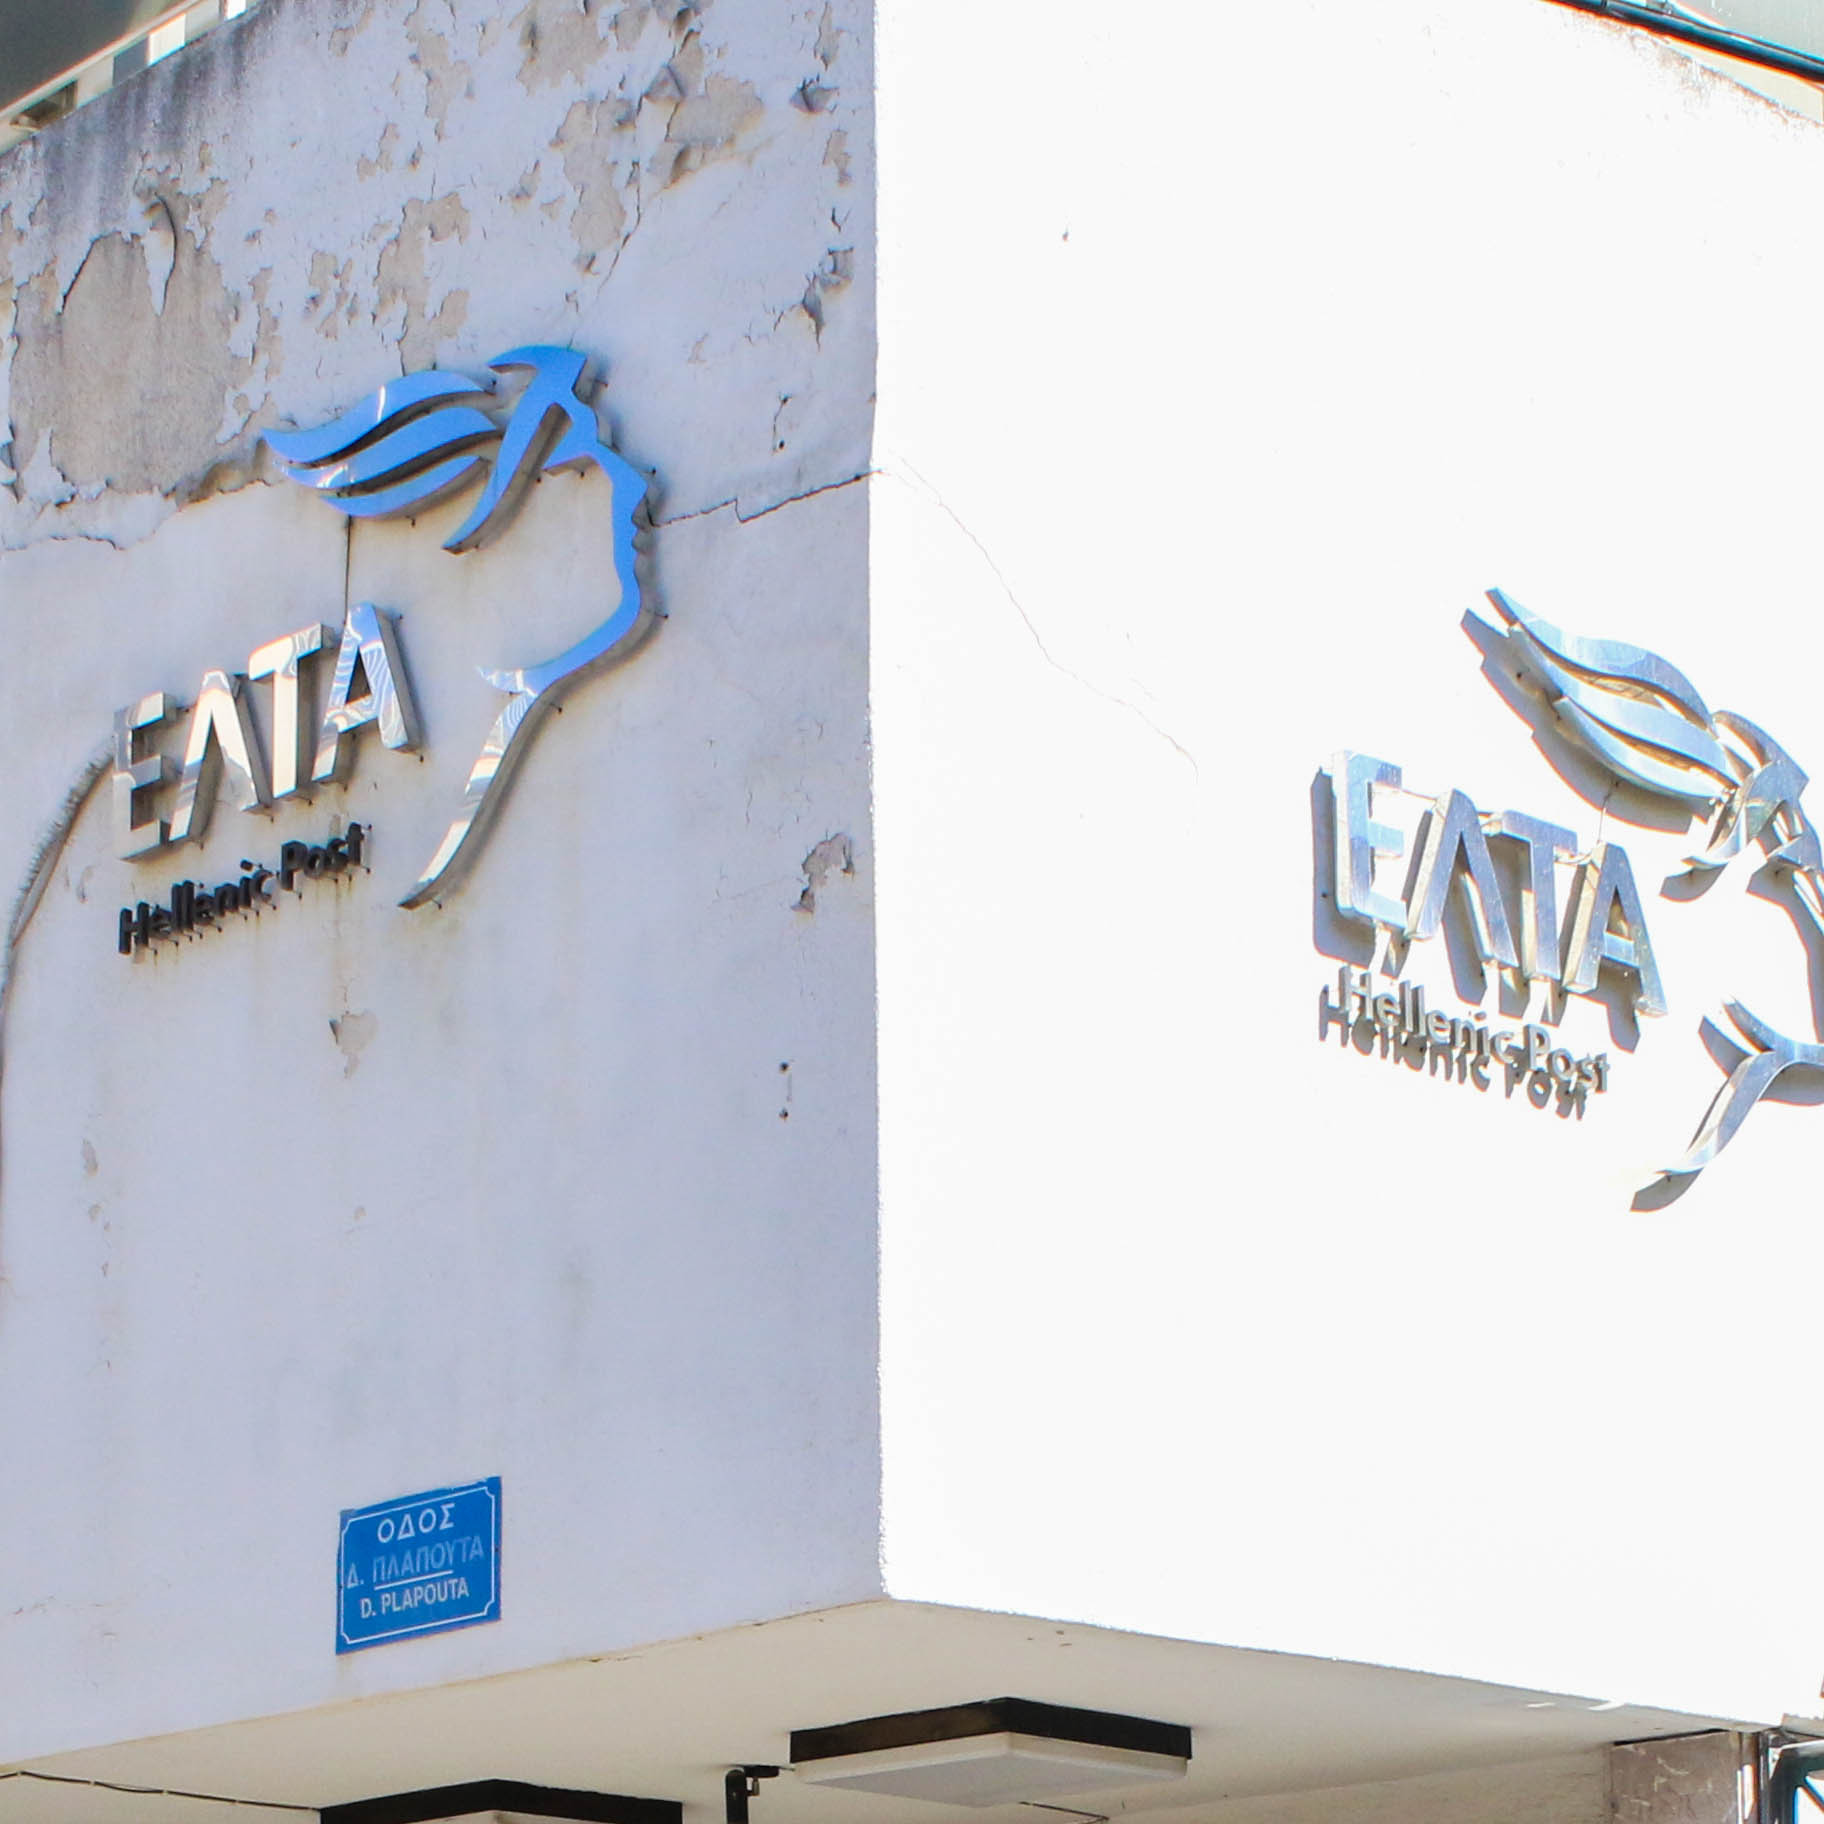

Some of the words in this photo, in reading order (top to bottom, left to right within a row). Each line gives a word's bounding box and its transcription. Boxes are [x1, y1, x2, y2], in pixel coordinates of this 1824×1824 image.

[112, 602, 420, 861] ΕΛΤΑ
[119, 861, 275, 955] Hellenic
[279, 822, 366, 892] Post
[1333, 750, 1667, 1018] ΕΛΤΑ
[1339, 966, 1515, 1066] Hellenic
[1524, 1024, 1611, 1094] Post
[346, 1563, 365, 1589] Δ.
[372, 1536, 485, 1583] ΠΛΑΠΟΥΤΑ
[377, 1503, 455, 1543] ΟΔΟΣ
[360, 1598, 377, 1619] D.
[381, 1577, 469, 1614] PLAPOUTA
